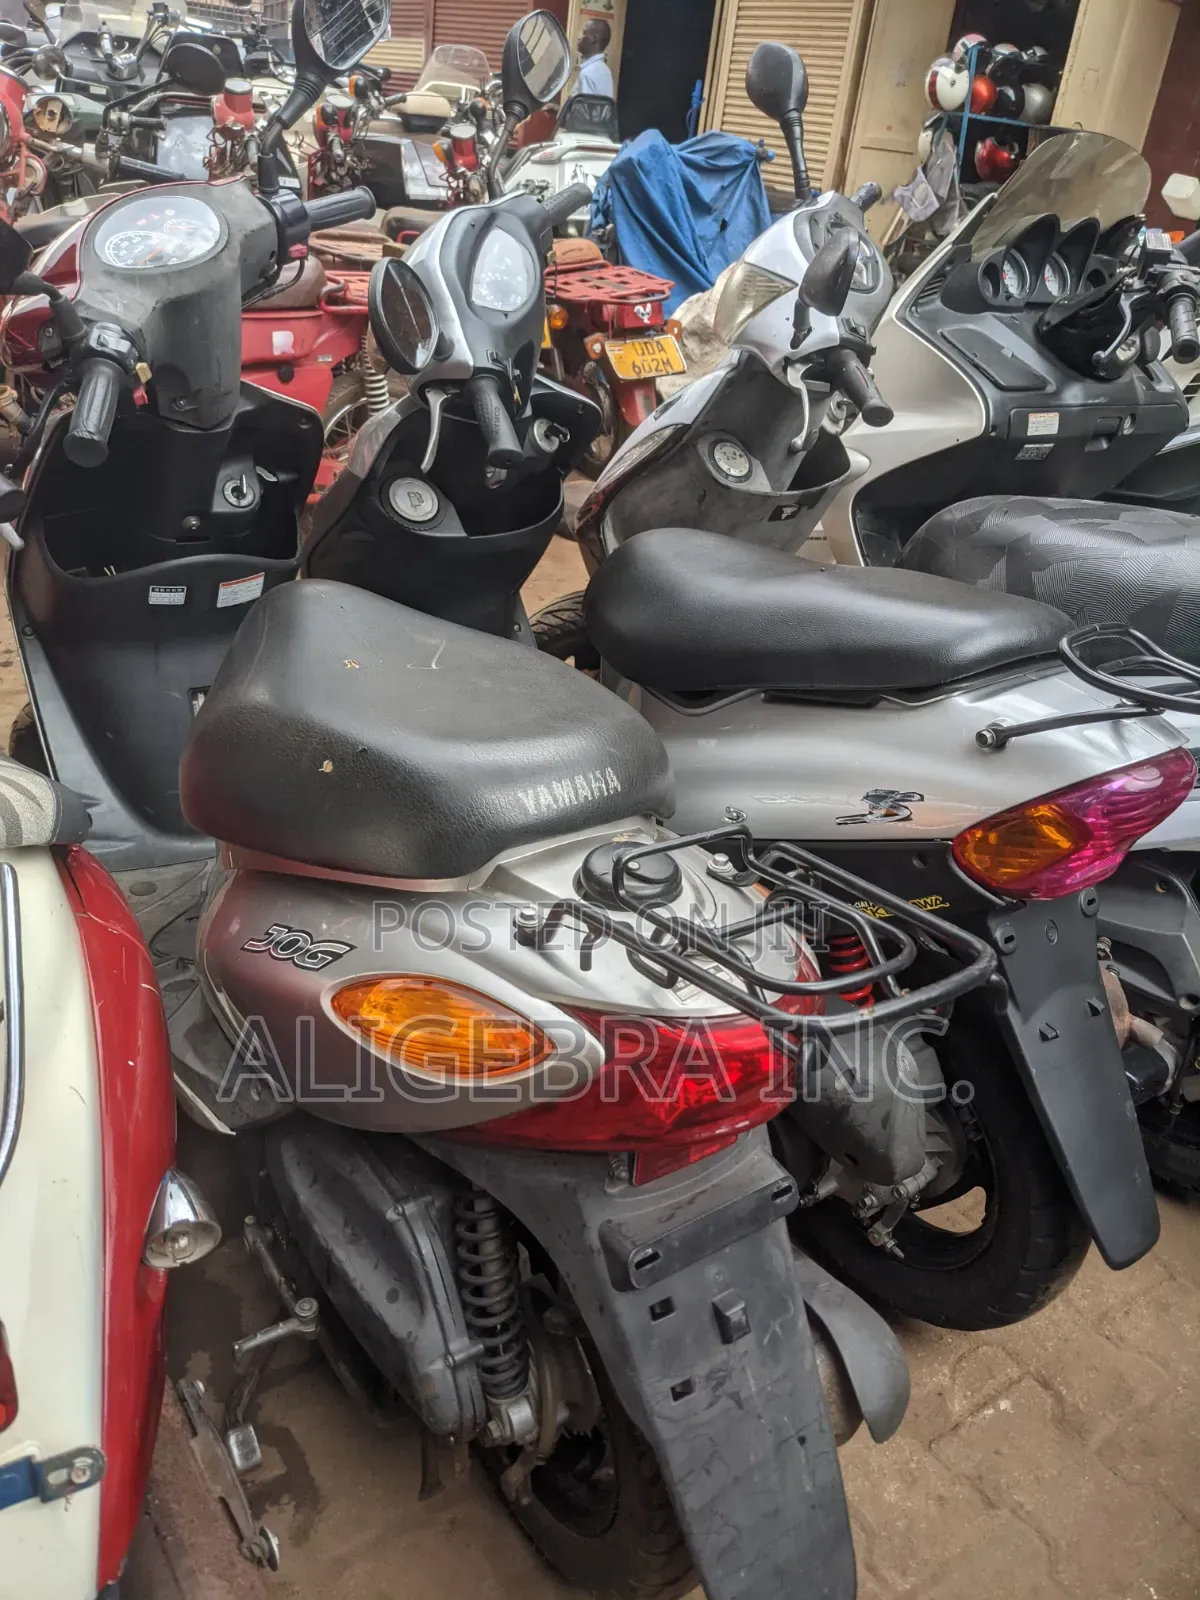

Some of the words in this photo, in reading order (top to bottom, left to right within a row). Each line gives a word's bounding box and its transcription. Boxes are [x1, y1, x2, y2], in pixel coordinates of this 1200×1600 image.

[631, 340, 668, 357] UDA
[631, 356, 674, 377] 602M
[517, 766, 621, 814] YAMAHA
[241, 923, 357, 971] JOG
